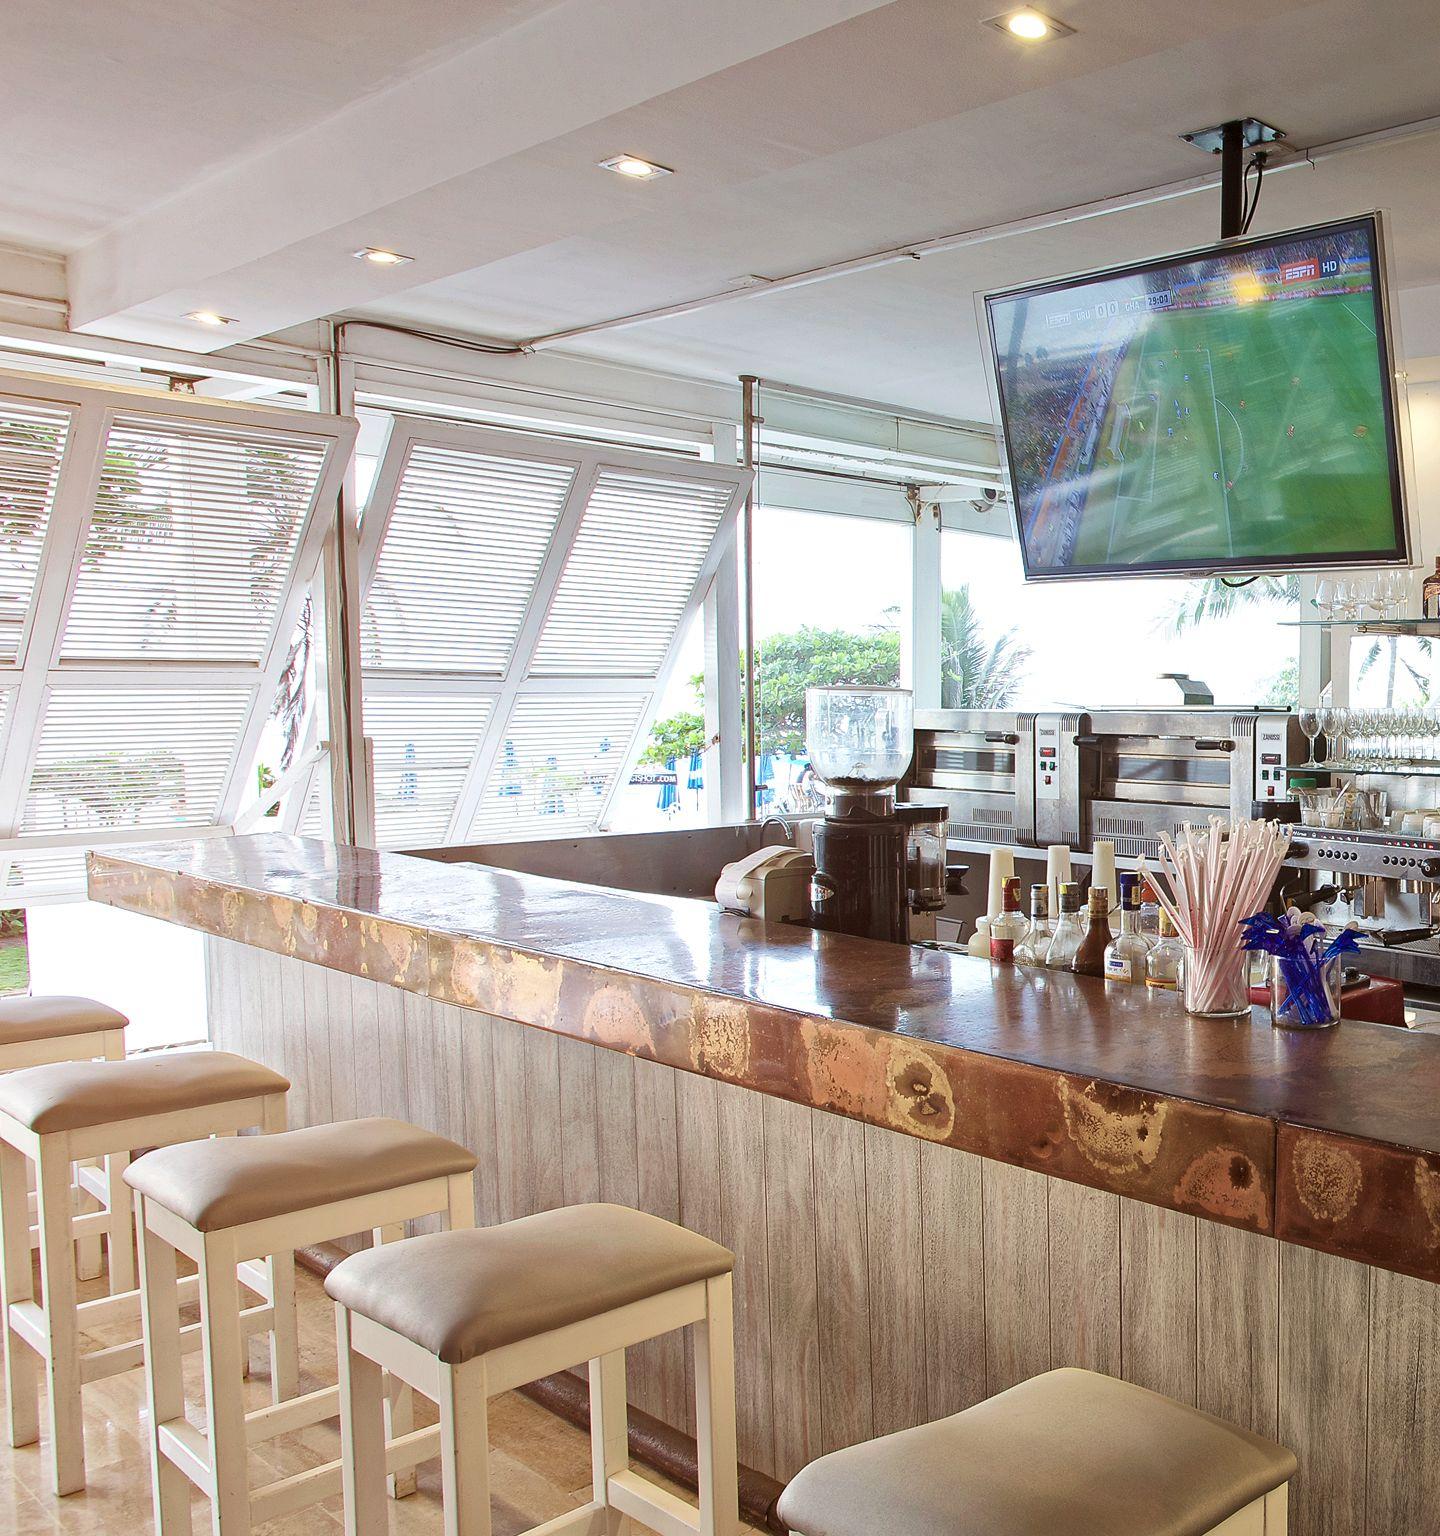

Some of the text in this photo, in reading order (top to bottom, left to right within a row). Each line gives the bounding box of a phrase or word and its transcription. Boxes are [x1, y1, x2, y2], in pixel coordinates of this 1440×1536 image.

[1285, 260, 1338, 280] ESPN HD
[1075, 309, 1092, 321] URU
